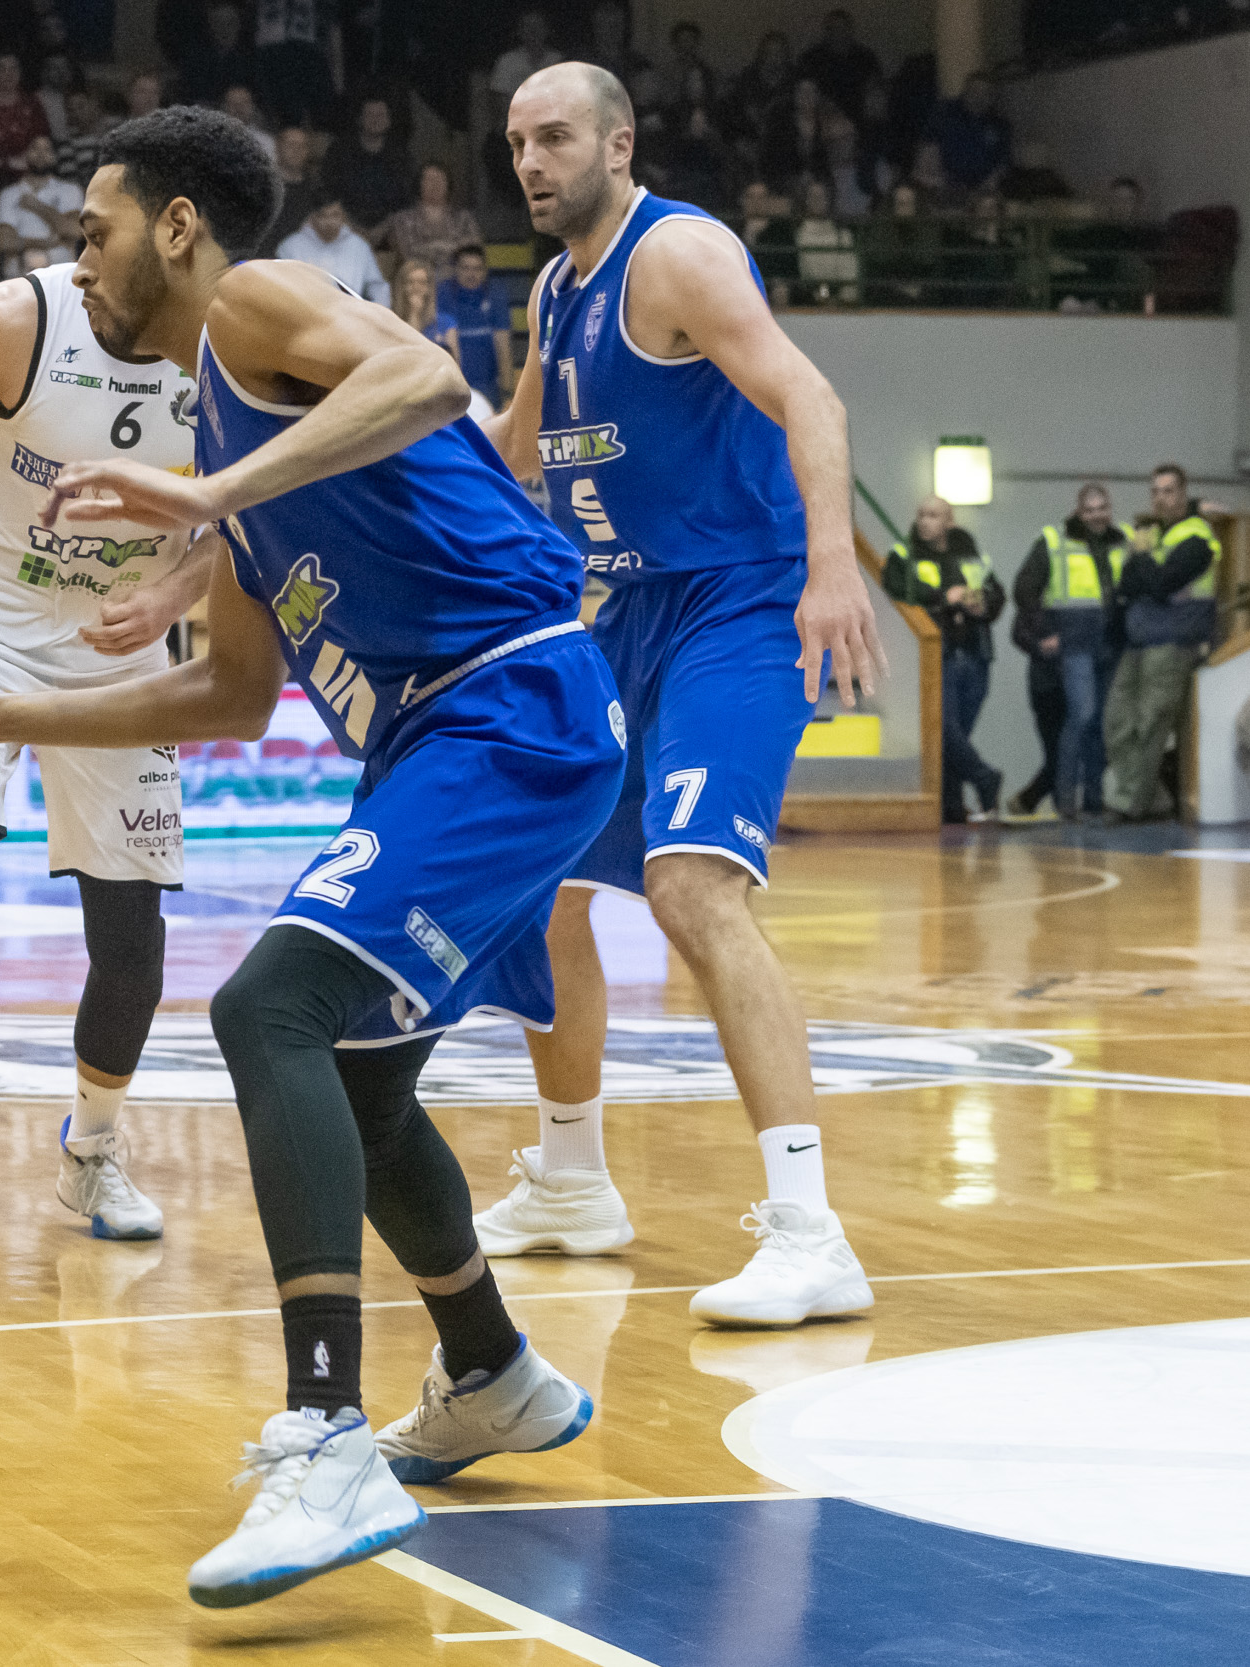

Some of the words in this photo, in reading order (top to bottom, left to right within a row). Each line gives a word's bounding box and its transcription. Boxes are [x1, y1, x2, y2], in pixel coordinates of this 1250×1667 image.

[108, 376, 162, 395] hummel
[110, 401, 144, 450] 6
[15, 455, 54, 488] TRAVE
[17, 445, 62, 478] FEHÉR
[580, 551, 642, 572] EA
[138, 771, 168, 783] alba
[665, 768, 707, 830] 7
[119, 808, 182, 832] Velen
[294, 829, 381, 909] 2
